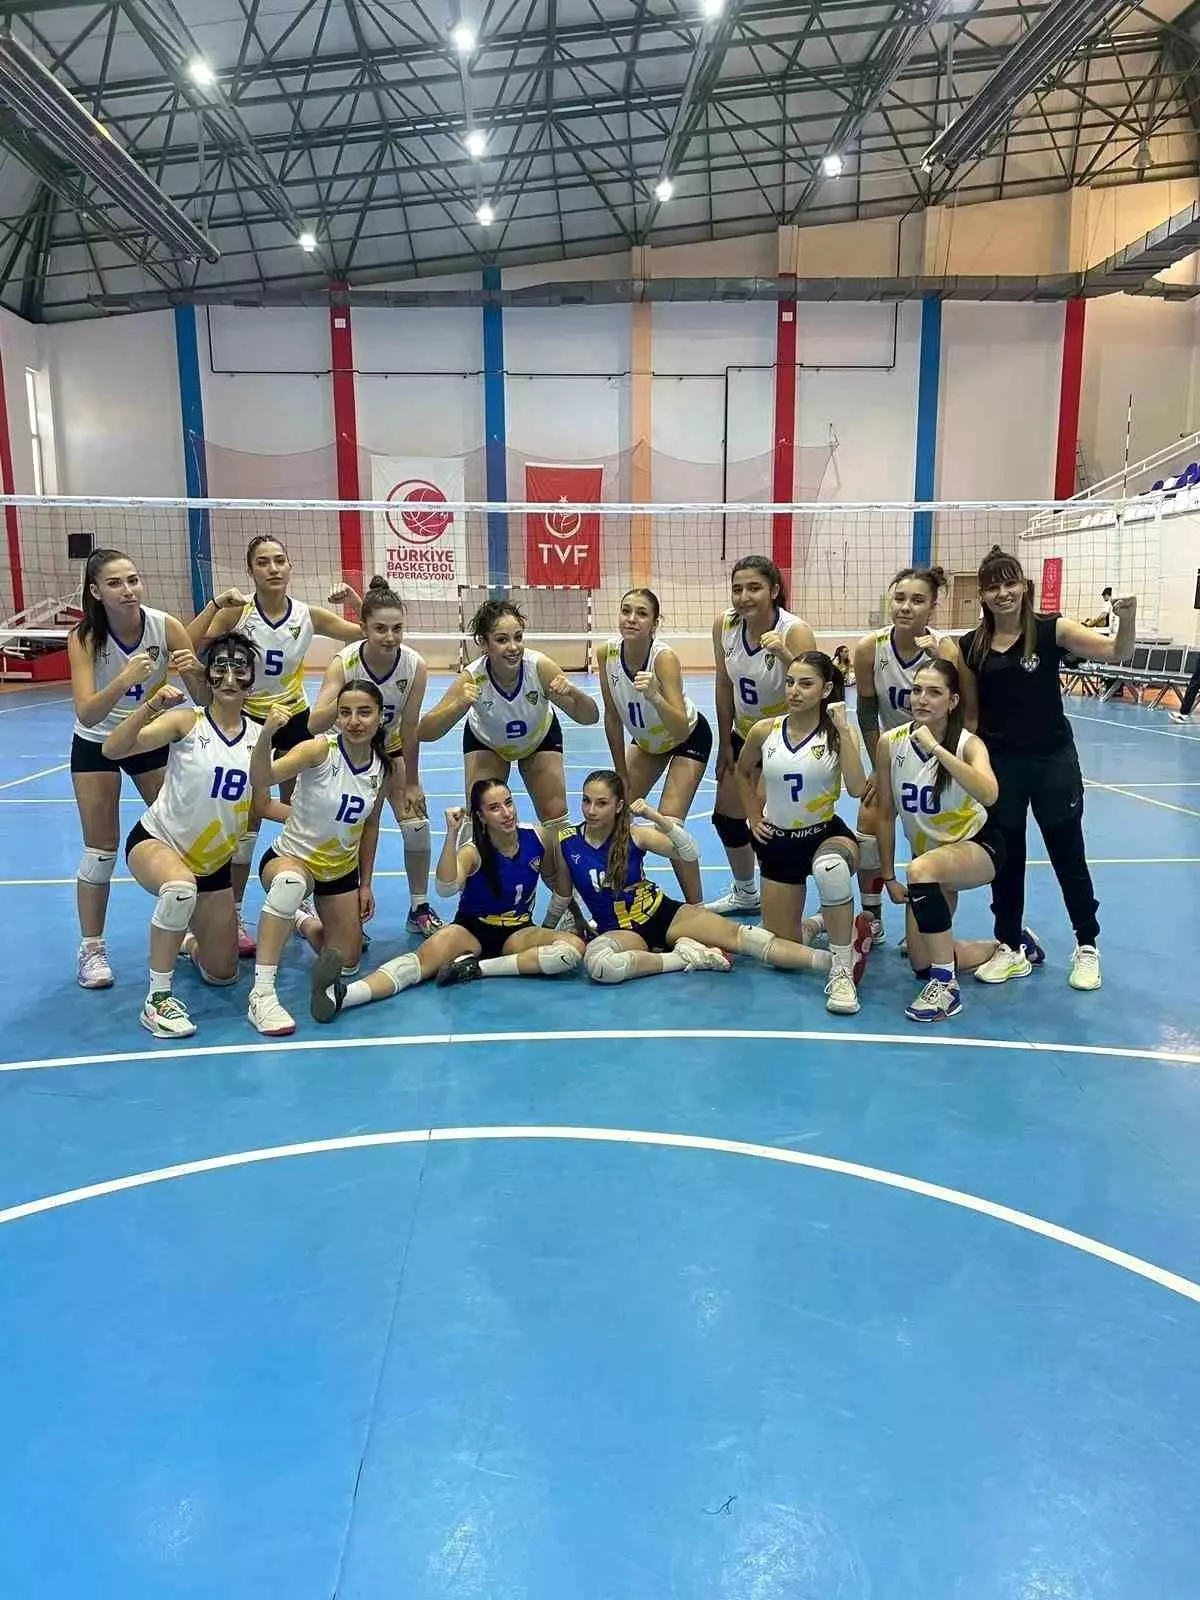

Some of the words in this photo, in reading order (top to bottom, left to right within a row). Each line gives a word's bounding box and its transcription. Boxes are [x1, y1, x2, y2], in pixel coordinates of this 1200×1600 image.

[386, 545, 454, 562] TÜRKİYE
[538, 544, 589, 565] TVF
[387, 562, 455, 572] BASKETBOL
[387, 571, 455, 580] FEDERASYONU
[264, 649, 284, 676] 5
[125, 683, 145, 701] 4
[739, 677, 759, 705] 6
[627, 701, 645, 729] 11
[506, 720, 528, 739] 9
[210, 766, 248, 801] 18
[783, 773, 804, 803] 7
[335, 793, 365, 824] 12
[901, 782, 941, 815] 20
[790, 826, 823, 839] NIKE
